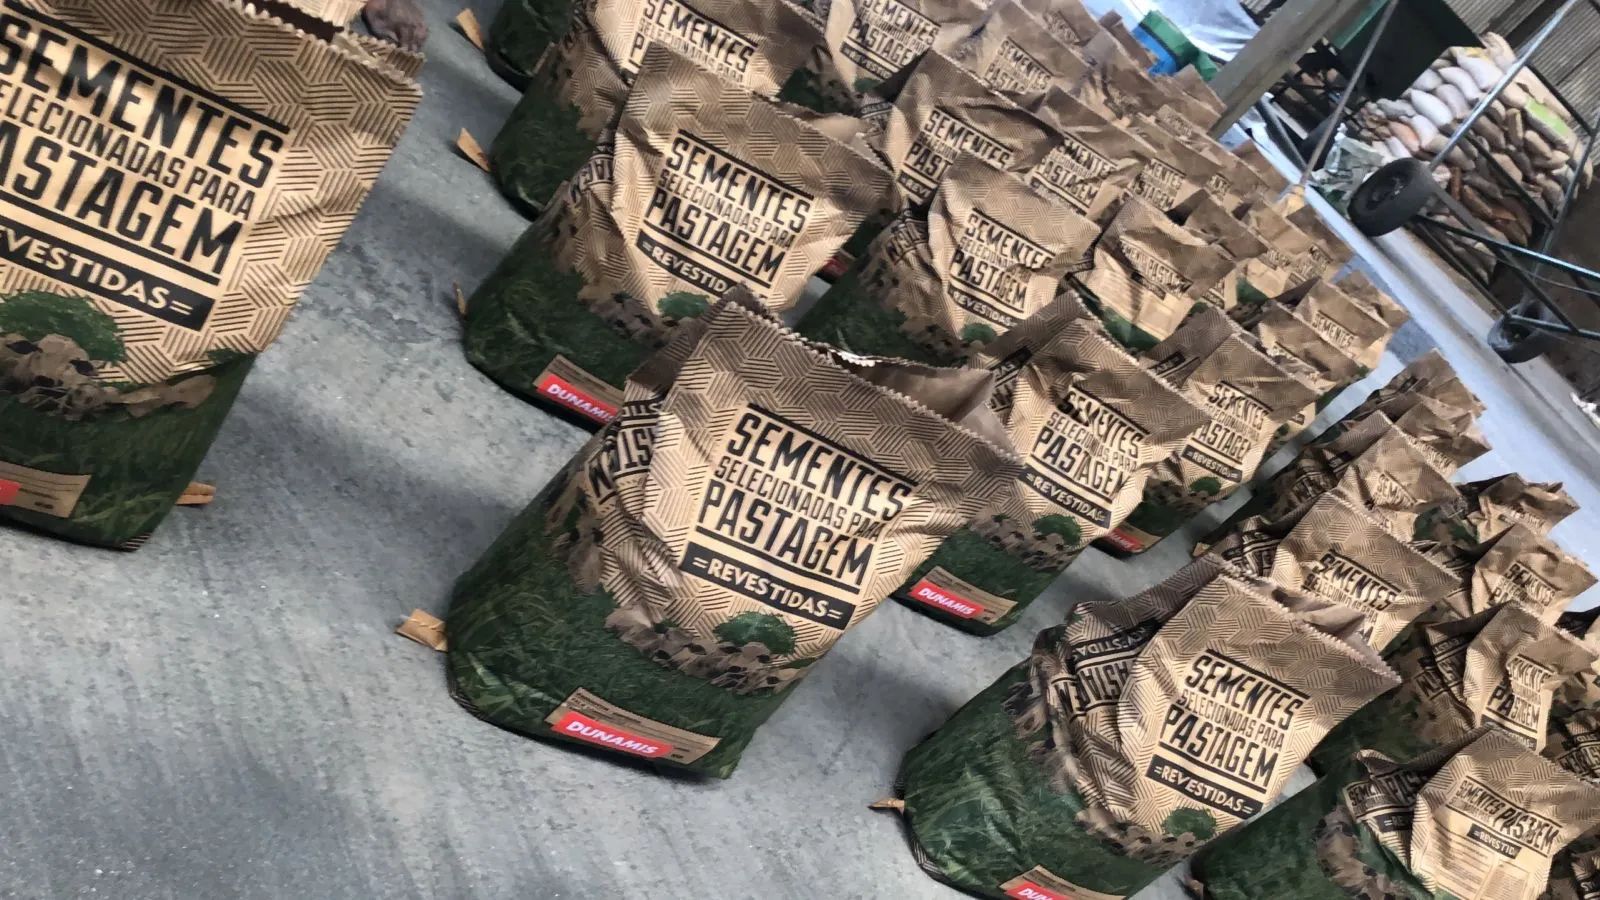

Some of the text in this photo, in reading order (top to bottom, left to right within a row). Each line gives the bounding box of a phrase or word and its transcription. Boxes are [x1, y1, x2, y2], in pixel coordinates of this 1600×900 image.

[644, 0, 755, 73] SEMENTES
[850, 17, 912, 67] PASTAGE
[0, 13, 285, 188] SEMENTES
[0, 79, 257, 221] LECIONADAS PARA
[665, 136, 811, 234] SEMENTES
[906, 142, 953, 181] PAST
[0, 120, 245, 276] ASTAGEM
[645, 187, 786, 283] PASTAGEM
[658, 168, 761, 234] SELECIONADAS
[761, 220, 795, 250] PARA
[727, 412, 912, 523] SEMENTES
[1198, 420, 1252, 460] ASTAGE
[697, 479, 875, 588] PASTAGEM
[714, 455, 843, 530] SELECIONADAS
[849, 511, 884, 541] PARA
[918, 587, 976, 615] DUNAMIS
[1312, 553, 1397, 612] SEMENTES
[1178, 690, 1285, 751] SELECIONADAS PARA
[1185, 655, 1303, 730] SEMENTES
[566, 720, 659, 754] DUNAMIS
[1159, 704, 1278, 787] PASTAGEM
